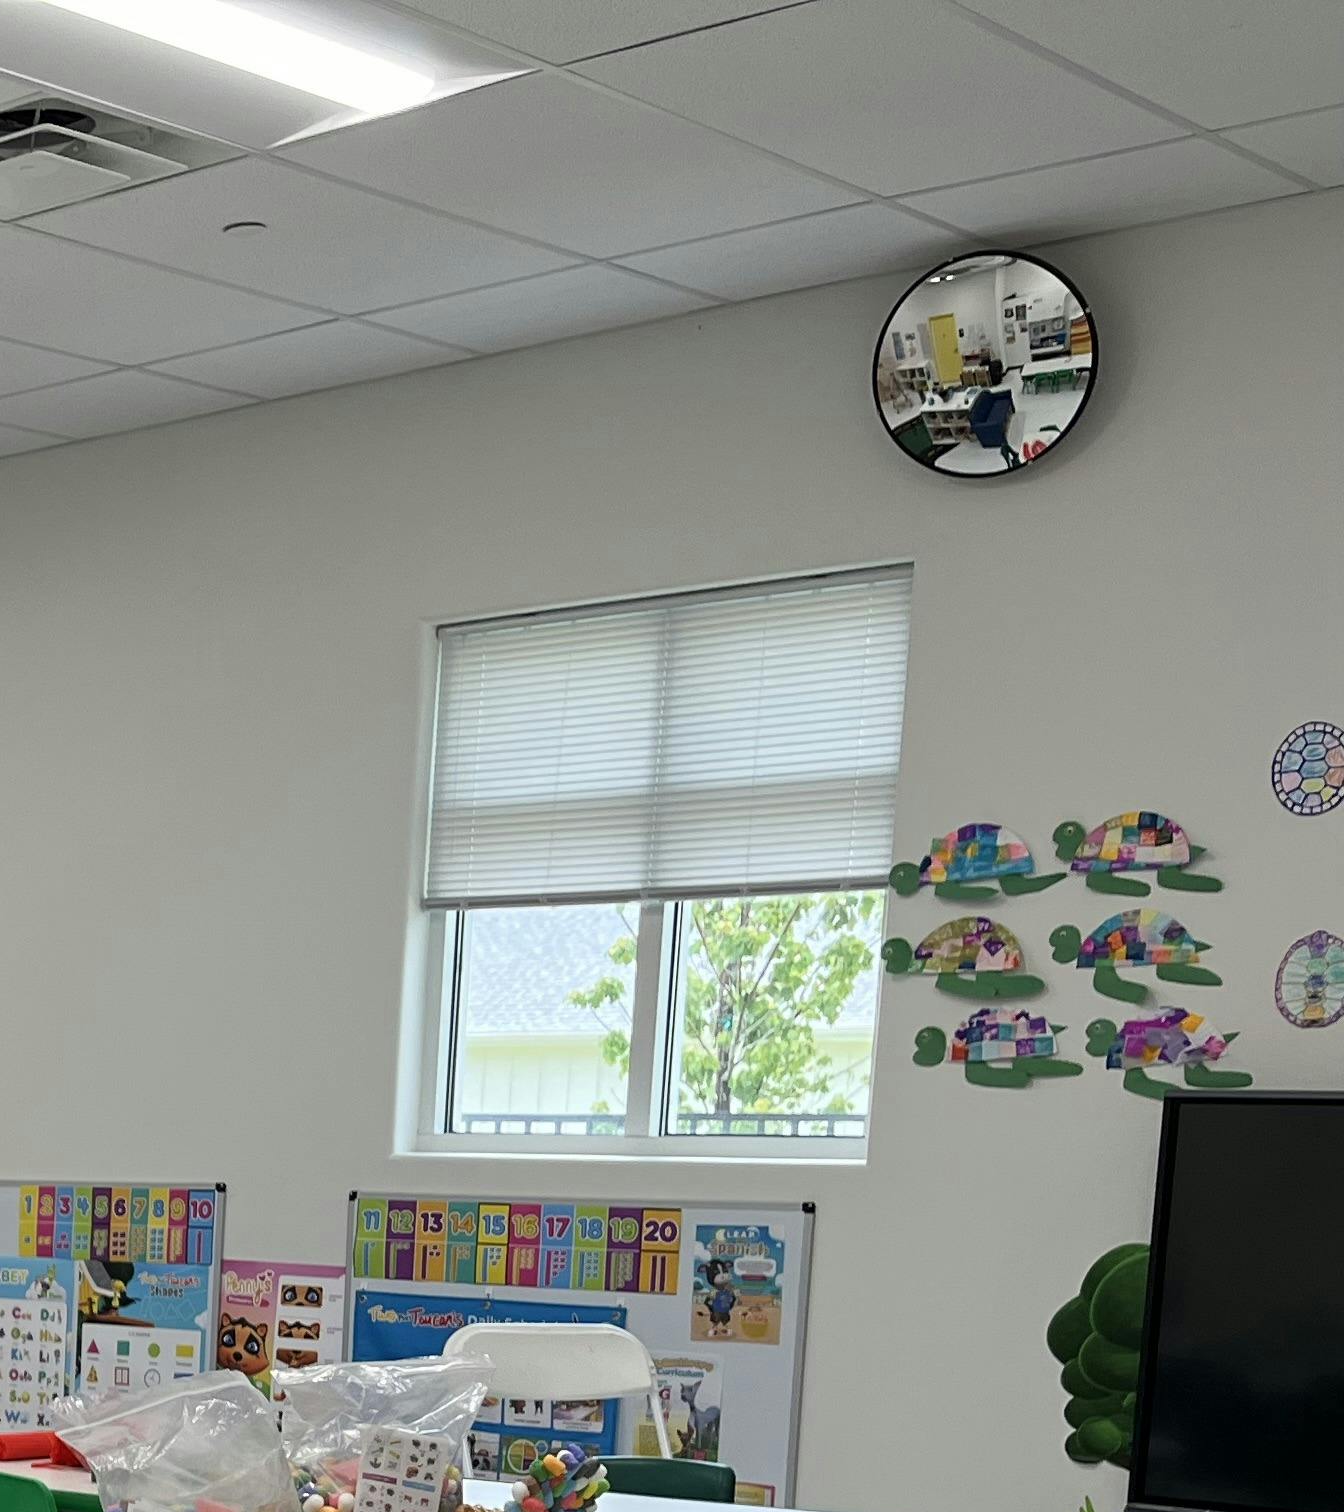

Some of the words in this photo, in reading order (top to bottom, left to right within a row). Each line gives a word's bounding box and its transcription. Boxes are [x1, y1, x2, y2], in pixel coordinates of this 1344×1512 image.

[24, 1194, 33, 1215] 1
[39, 1194, 54, 1216] 2
[59, 1195, 72, 1215] 3
[77, 1195, 90, 1216] 4
[94, 1196, 109, 1218] 5
[113, 1197, 127, 1217] 6
[132, 1198, 147, 1218] 7
[152, 1197, 165, 1218] 8
[170, 1197, 185, 1220] 9
[190, 1199, 212, 1220] 10
[363, 1209, 381, 1232] 11
[389, 1209, 414, 1233] 12
[420, 1211, 443, 1234] 13
[449, 1211, 475, 1235] 14
[482, 1214, 506, 1236] 15
[513, 1214, 539, 1239] 16
[544, 1215, 571, 1239] 17
[577, 1216, 604, 1241] 18
[610, 1217, 639, 1243] 19
[643, 1219, 679, 1243] 20
